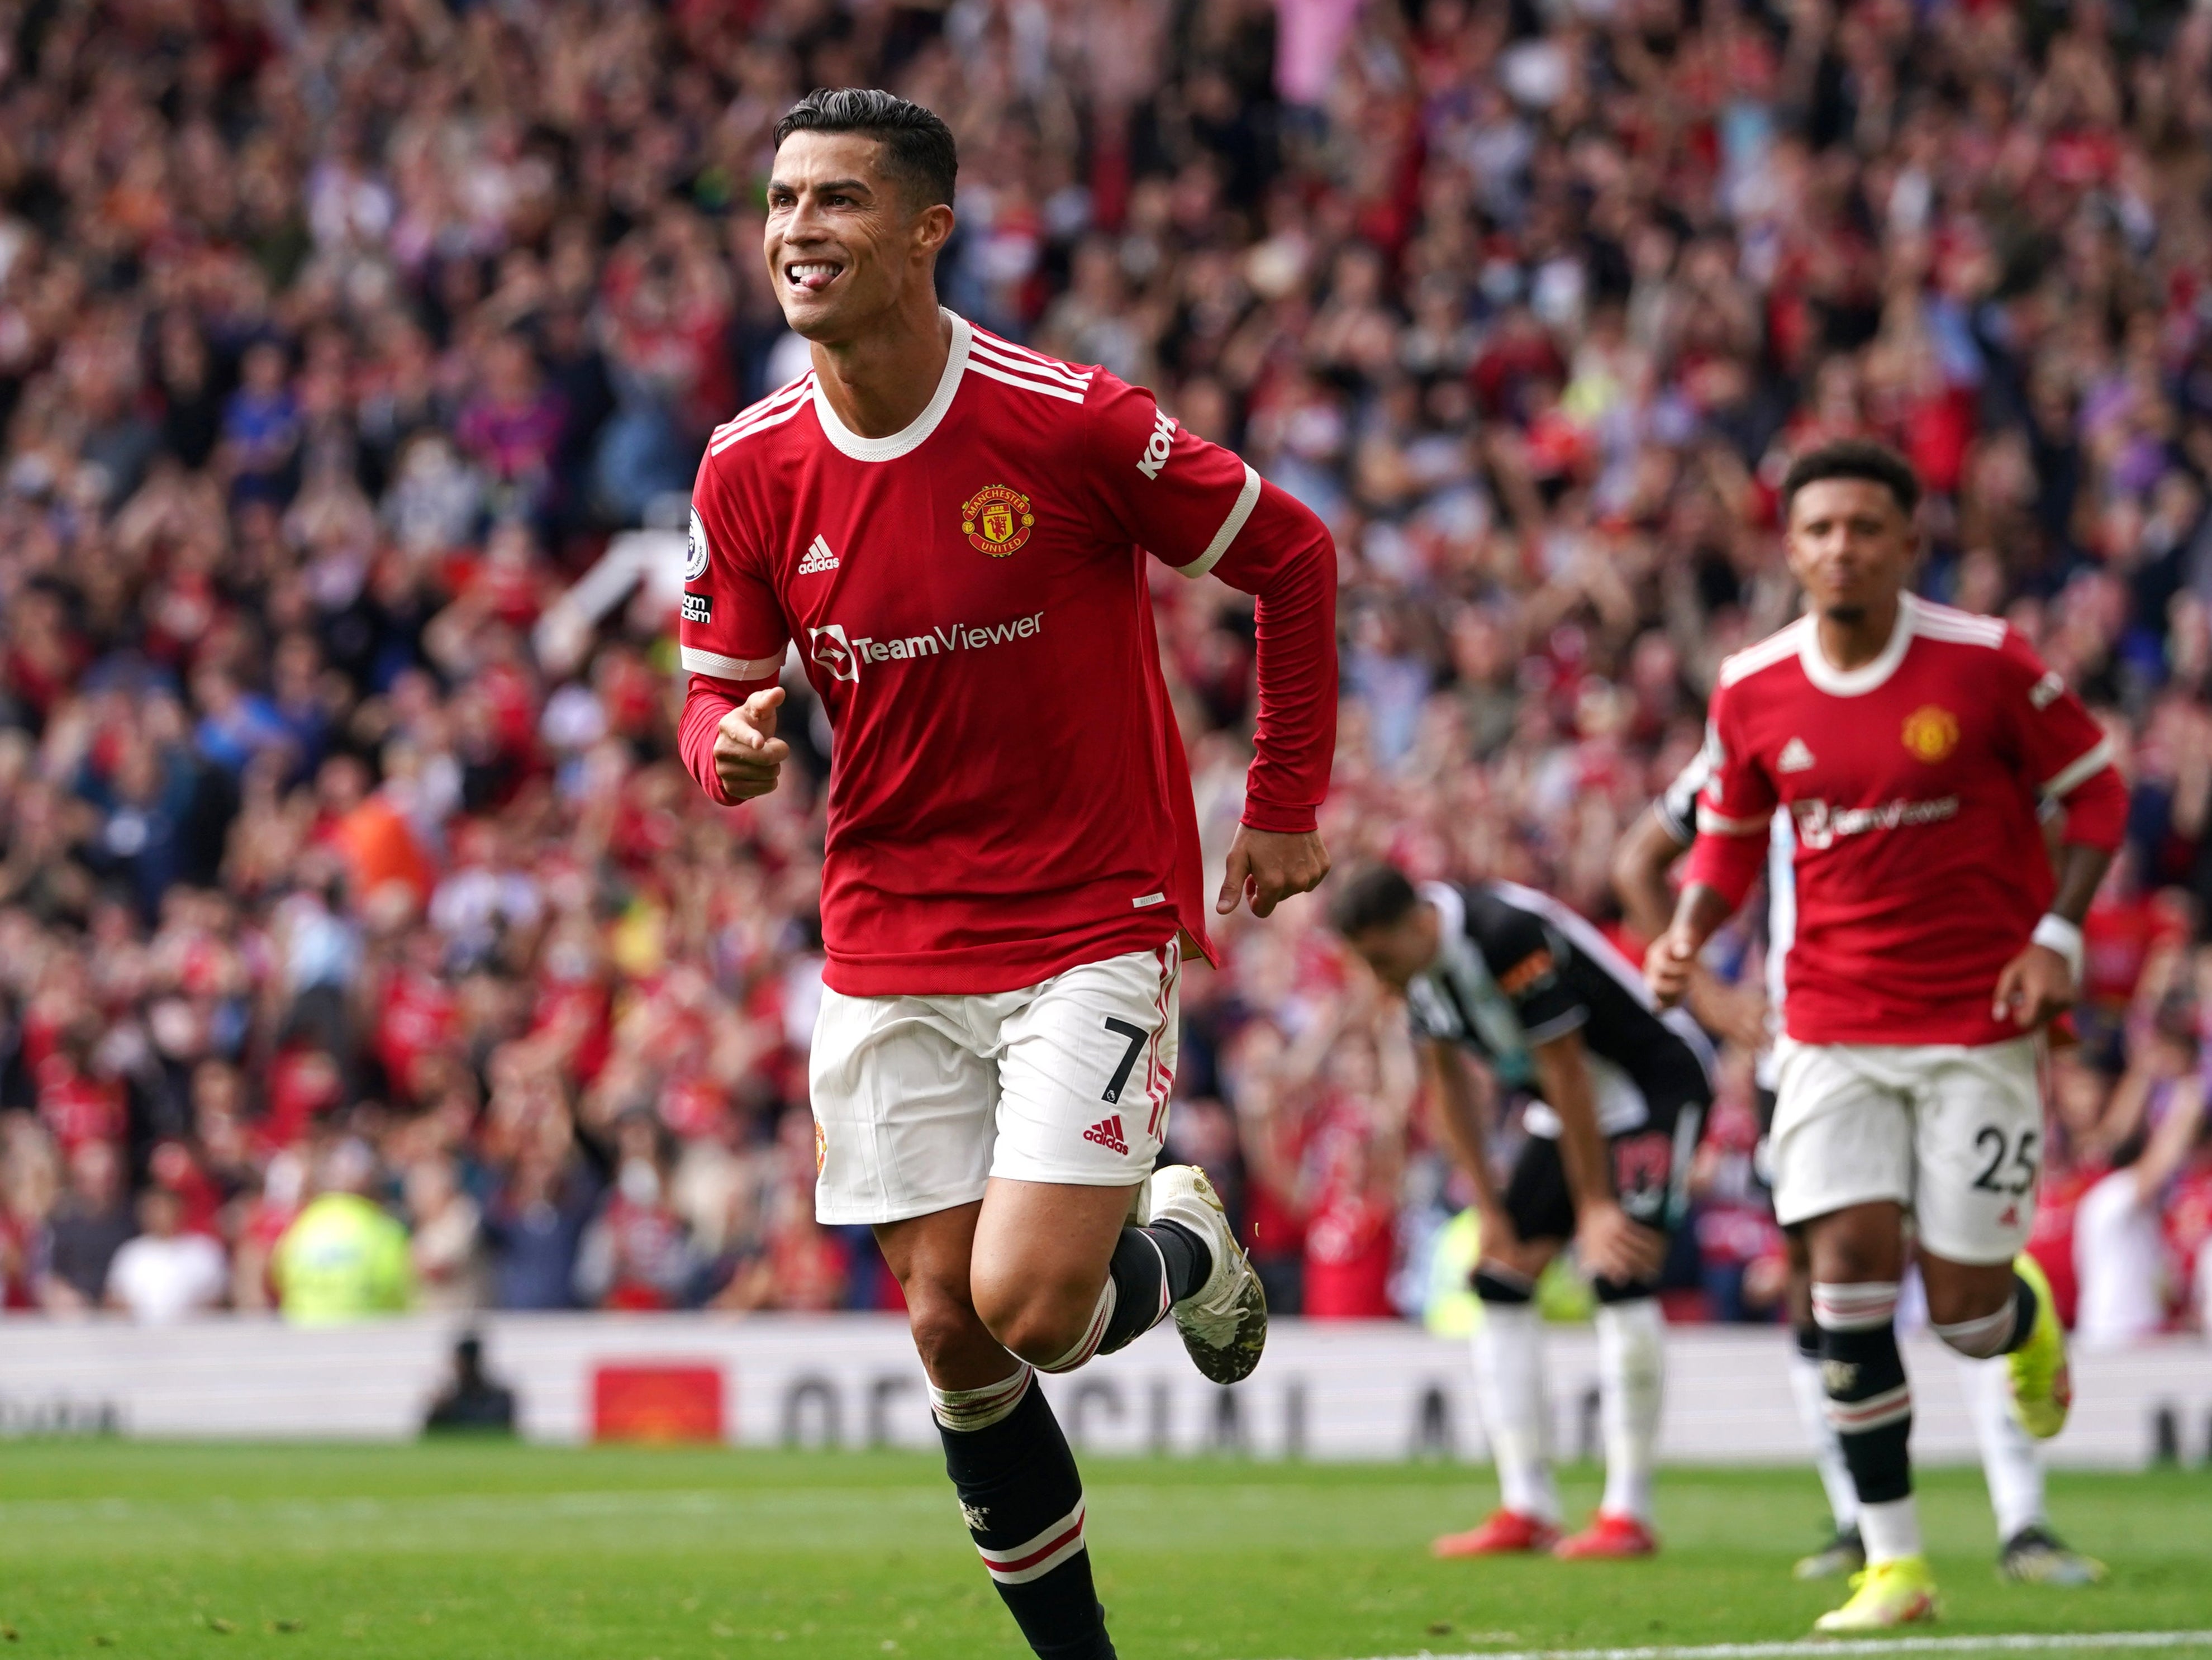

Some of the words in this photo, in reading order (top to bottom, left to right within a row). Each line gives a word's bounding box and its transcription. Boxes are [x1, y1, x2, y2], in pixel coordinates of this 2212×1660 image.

[1136, 406, 1176, 481] KOH
[968, 490, 1025, 516] MANCHESTER
[981, 538, 1021, 553] UNITED
[798, 557, 840, 575] adidas
[851, 611, 1044, 664] TeamViewer
[1101, 1016, 1149, 1105] 7
[1083, 1130, 1129, 1155] adidas
[1972, 1126, 2037, 1196] 25
